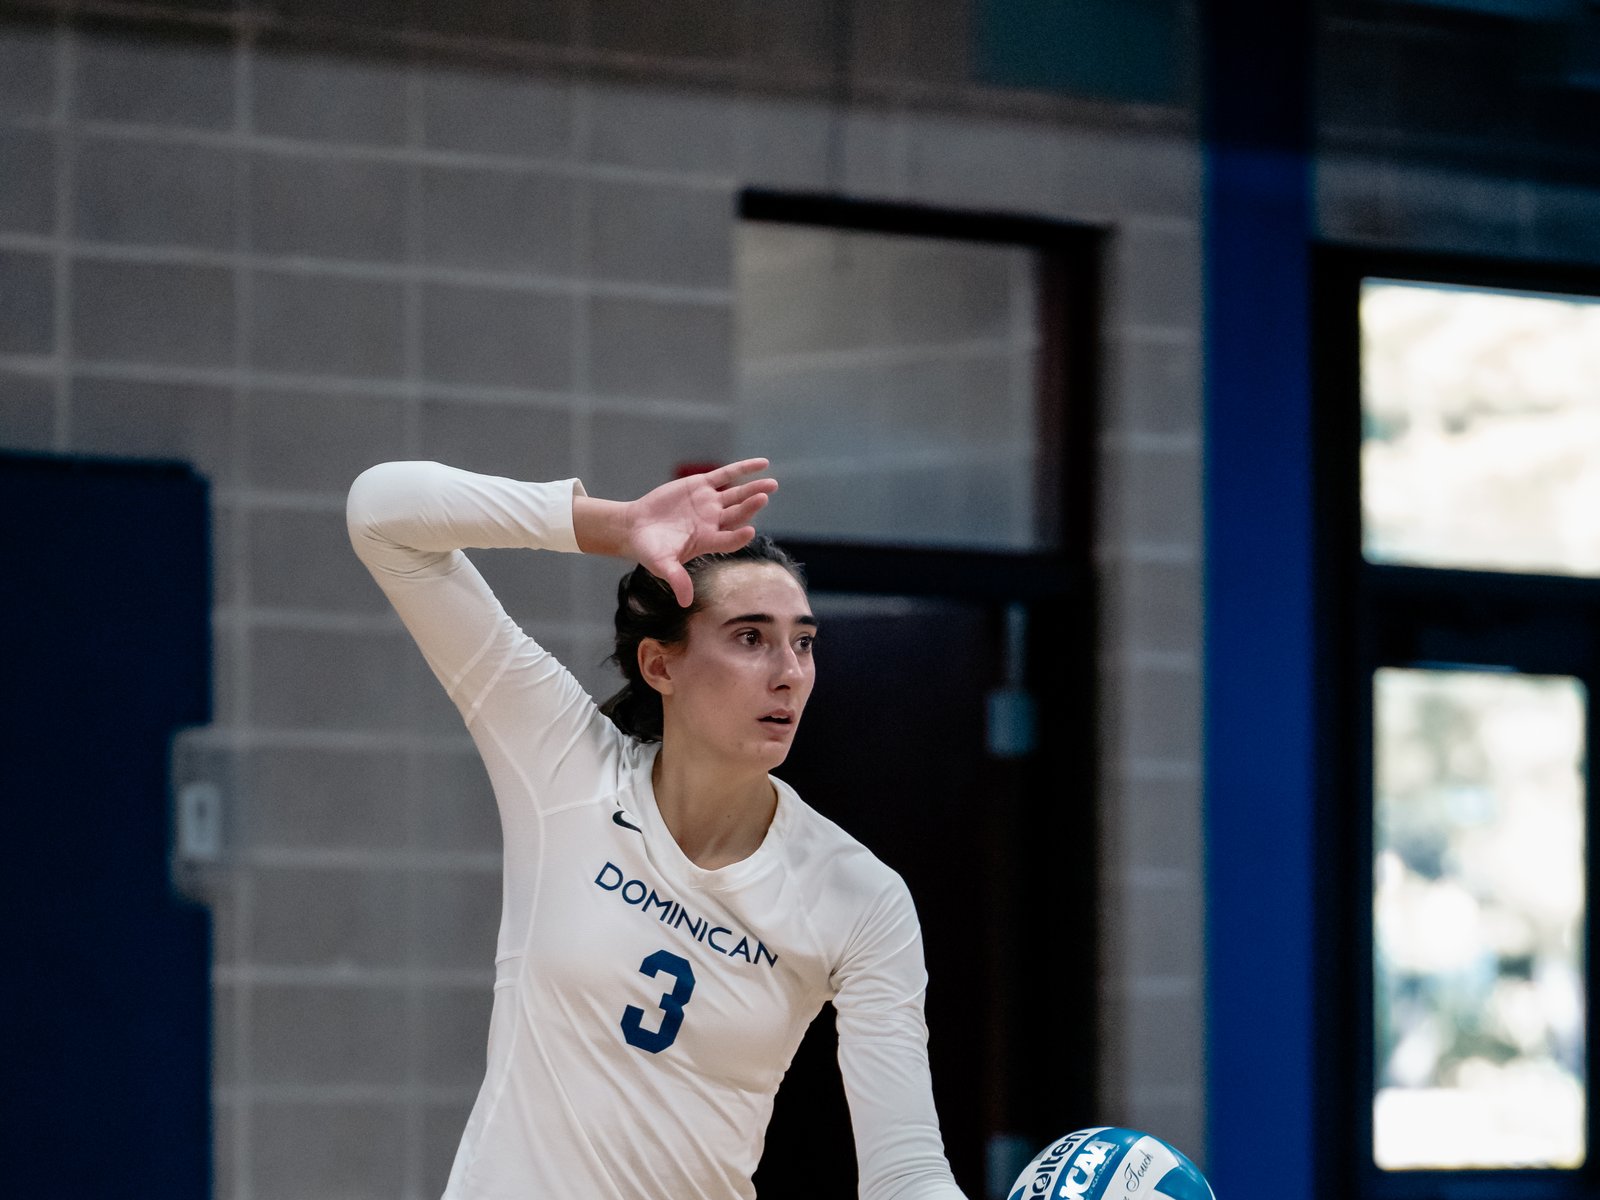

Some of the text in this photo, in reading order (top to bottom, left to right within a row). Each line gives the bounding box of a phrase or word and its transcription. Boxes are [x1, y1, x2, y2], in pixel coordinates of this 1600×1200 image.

[594, 862, 778, 968] DOMINICAN
[620, 949, 696, 1054] 3
[1124, 1149, 1153, 1192] Touch
